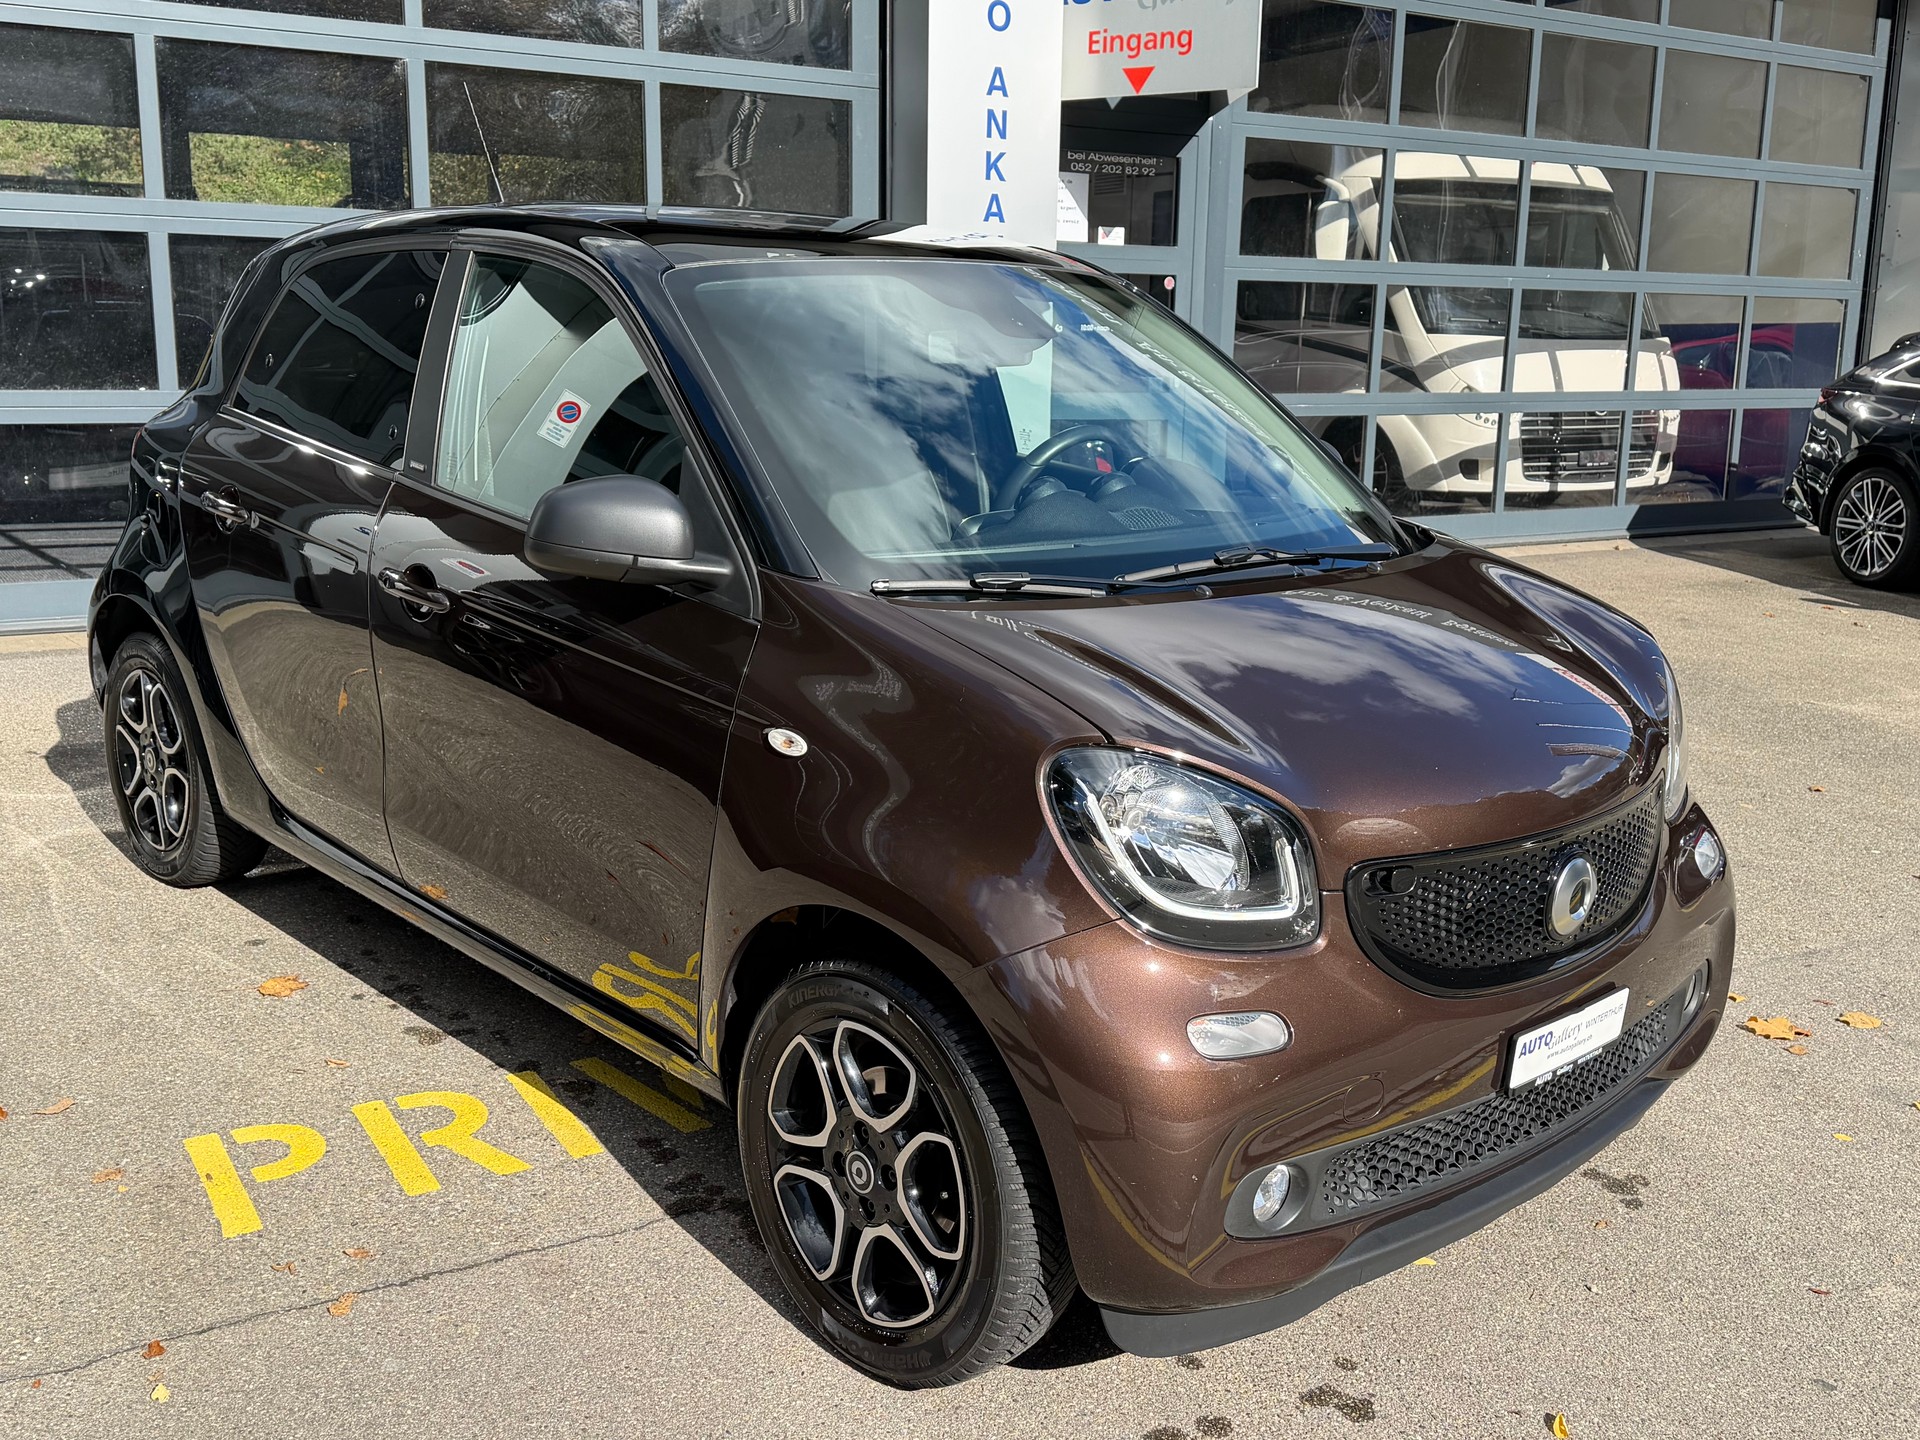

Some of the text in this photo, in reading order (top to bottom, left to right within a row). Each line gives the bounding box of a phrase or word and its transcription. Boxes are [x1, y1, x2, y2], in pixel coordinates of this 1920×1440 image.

[1088, 28, 1193, 59] Eingang
[982, 66, 1010, 224] ANKA
[1067, 150, 1086, 160] bei
[1088, 153, 1157, 165] Abwesenheit
[1070, 161, 1092, 172] 052
[1101, 164, 1123, 174] 202
[1125, 166, 1139, 176] 82
[1141, 167, 1156, 177] 92
[1518, 1030, 1554, 1059] AUTO
[1585, 1003, 1624, 1028] WINTERTHUR
